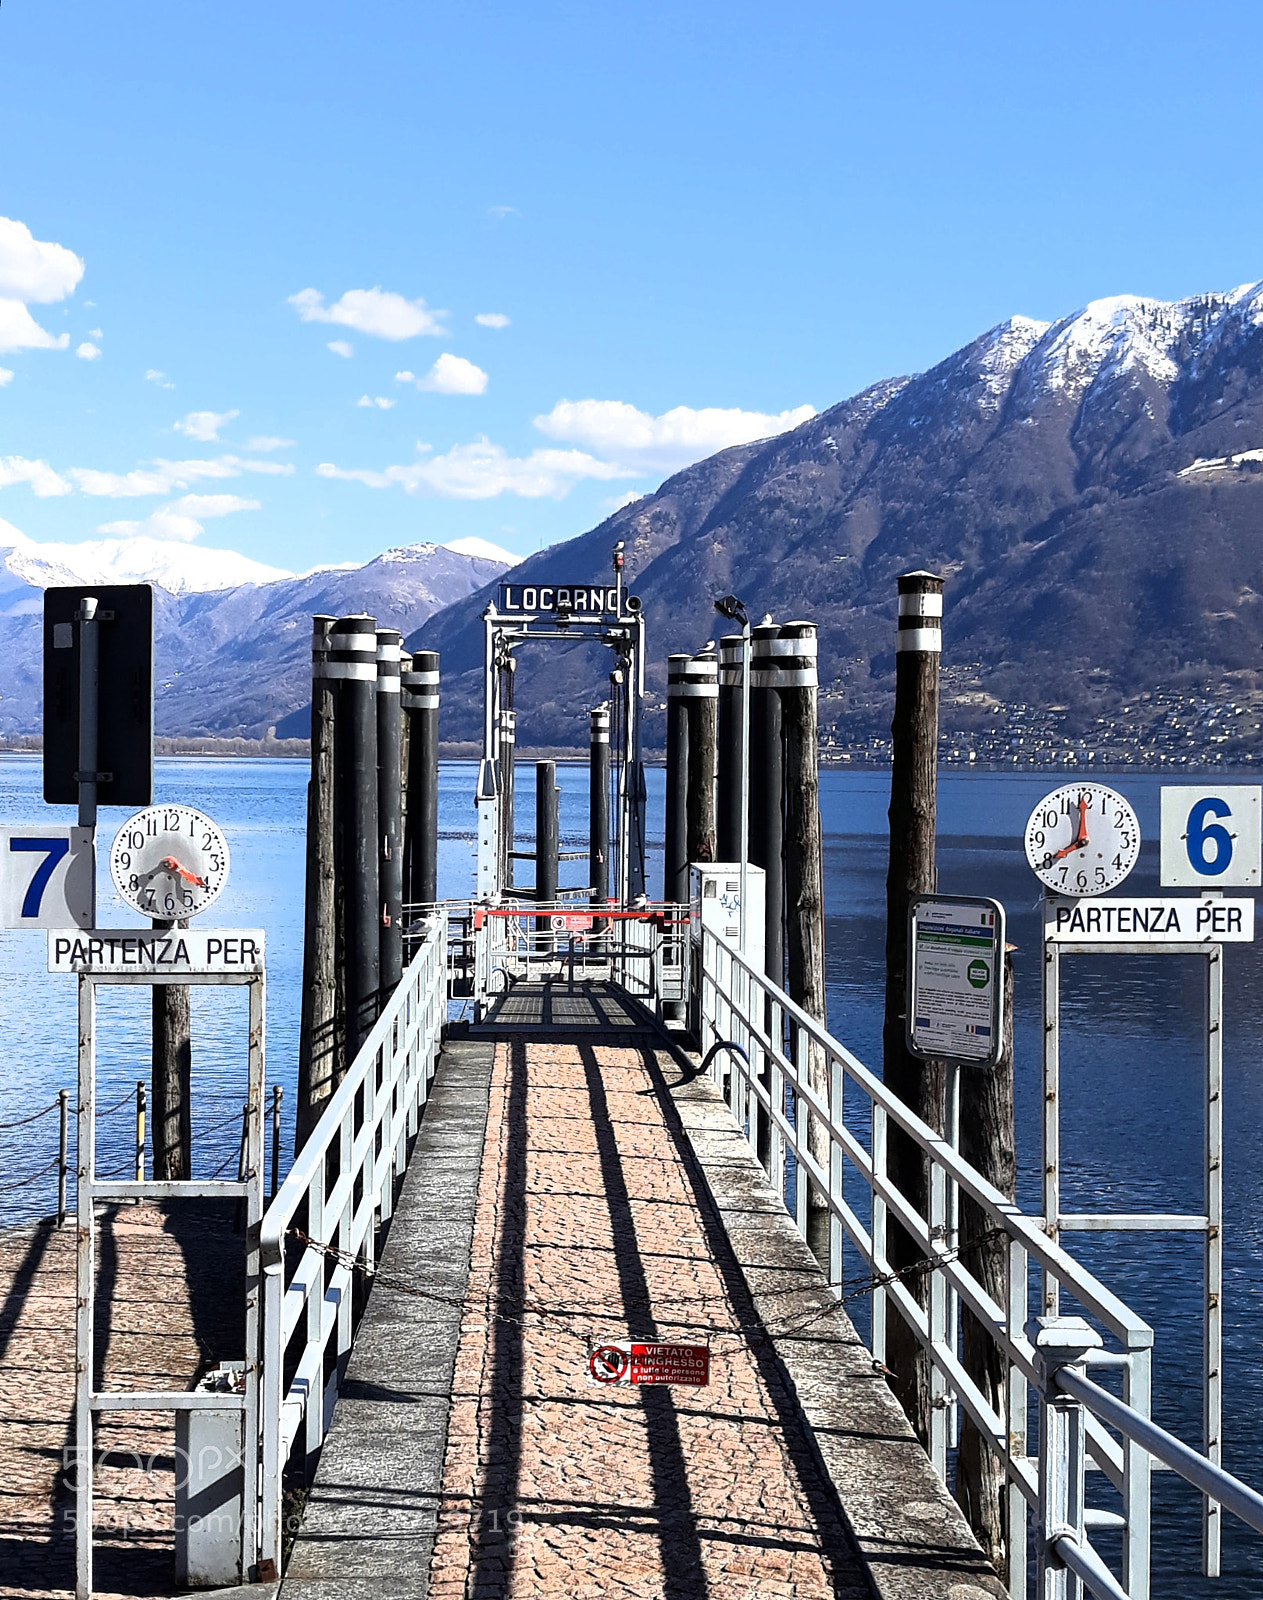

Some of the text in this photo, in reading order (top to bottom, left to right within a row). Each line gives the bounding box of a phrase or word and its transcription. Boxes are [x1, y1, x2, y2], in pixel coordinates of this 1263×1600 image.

[1060, 798, 1070, 815] 11
[1101, 798, 1106, 815] 1
[146, 819, 157, 836] 11
[163, 814, 180, 831] 12
[1042, 810, 1058, 828] 10
[1113, 811, 1124, 828] 2
[189, 820, 194, 837] 1
[1186, 797, 1233, 876] 6
[127, 831, 144, 850] 10
[202, 833, 212, 851] 2
[1035, 831, 1045, 848] 9
[1120, 832, 1130, 849] 3
[121, 852, 131, 870] 9
[209, 854, 219, 872] 3
[1042, 852, 1053, 870] 8
[1112, 853, 1122, 870] 4
[9, 837, 70, 918] 7
[129, 874, 139, 891] 8
[1058, 867, 1068, 884] 7
[1076, 870, 1087, 888] 6
[1095, 867, 1105, 885] 5
[145, 889, 156, 906] 7
[164, 893, 175, 910] 6
[183, 890, 194, 907] 5
[1056, 907, 1242, 932] PARTENZA PER
[55, 938, 256, 964] PARTENZA PER
[646, 1347, 693, 1357] VIETATO
[634, 1357, 704, 1368] L'INGRESSO
[640, 1366, 660, 1374] tutte
[671, 1368, 705, 1376] persone
